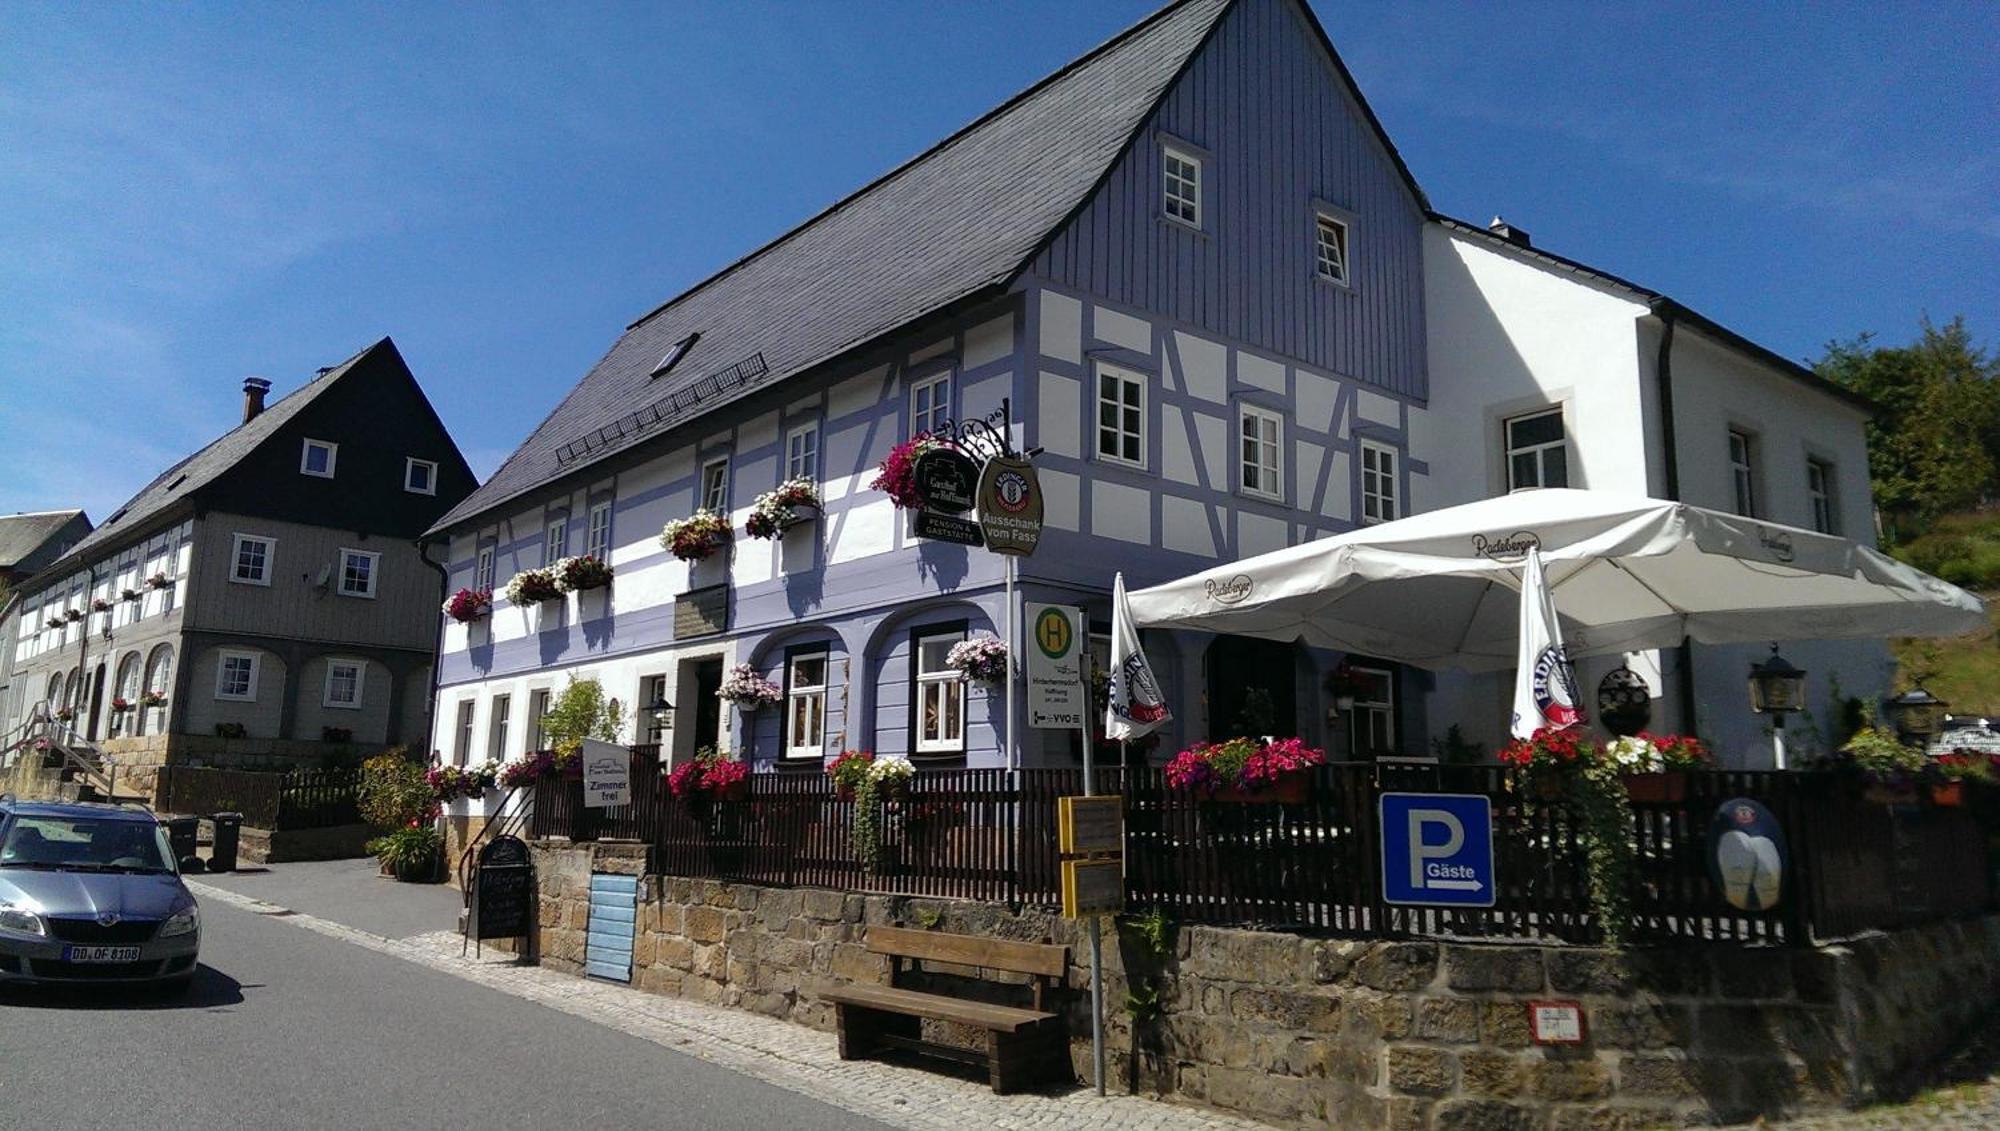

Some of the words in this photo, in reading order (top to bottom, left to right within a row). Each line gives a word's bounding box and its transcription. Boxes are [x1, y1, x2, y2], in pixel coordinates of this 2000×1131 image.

[929, 518, 964, 531] PENSION
[982, 512, 1040, 530] Ausschank
[987, 528, 1010, 539] vom
[1012, 529, 1037, 542] Fass
[1046, 618, 1062, 648] H
[590, 781, 627, 791] Zimmer
[601, 791, 618, 801] frei
[1408, 809, 1465, 888] P
[1427, 863, 1475, 878] Gäste
